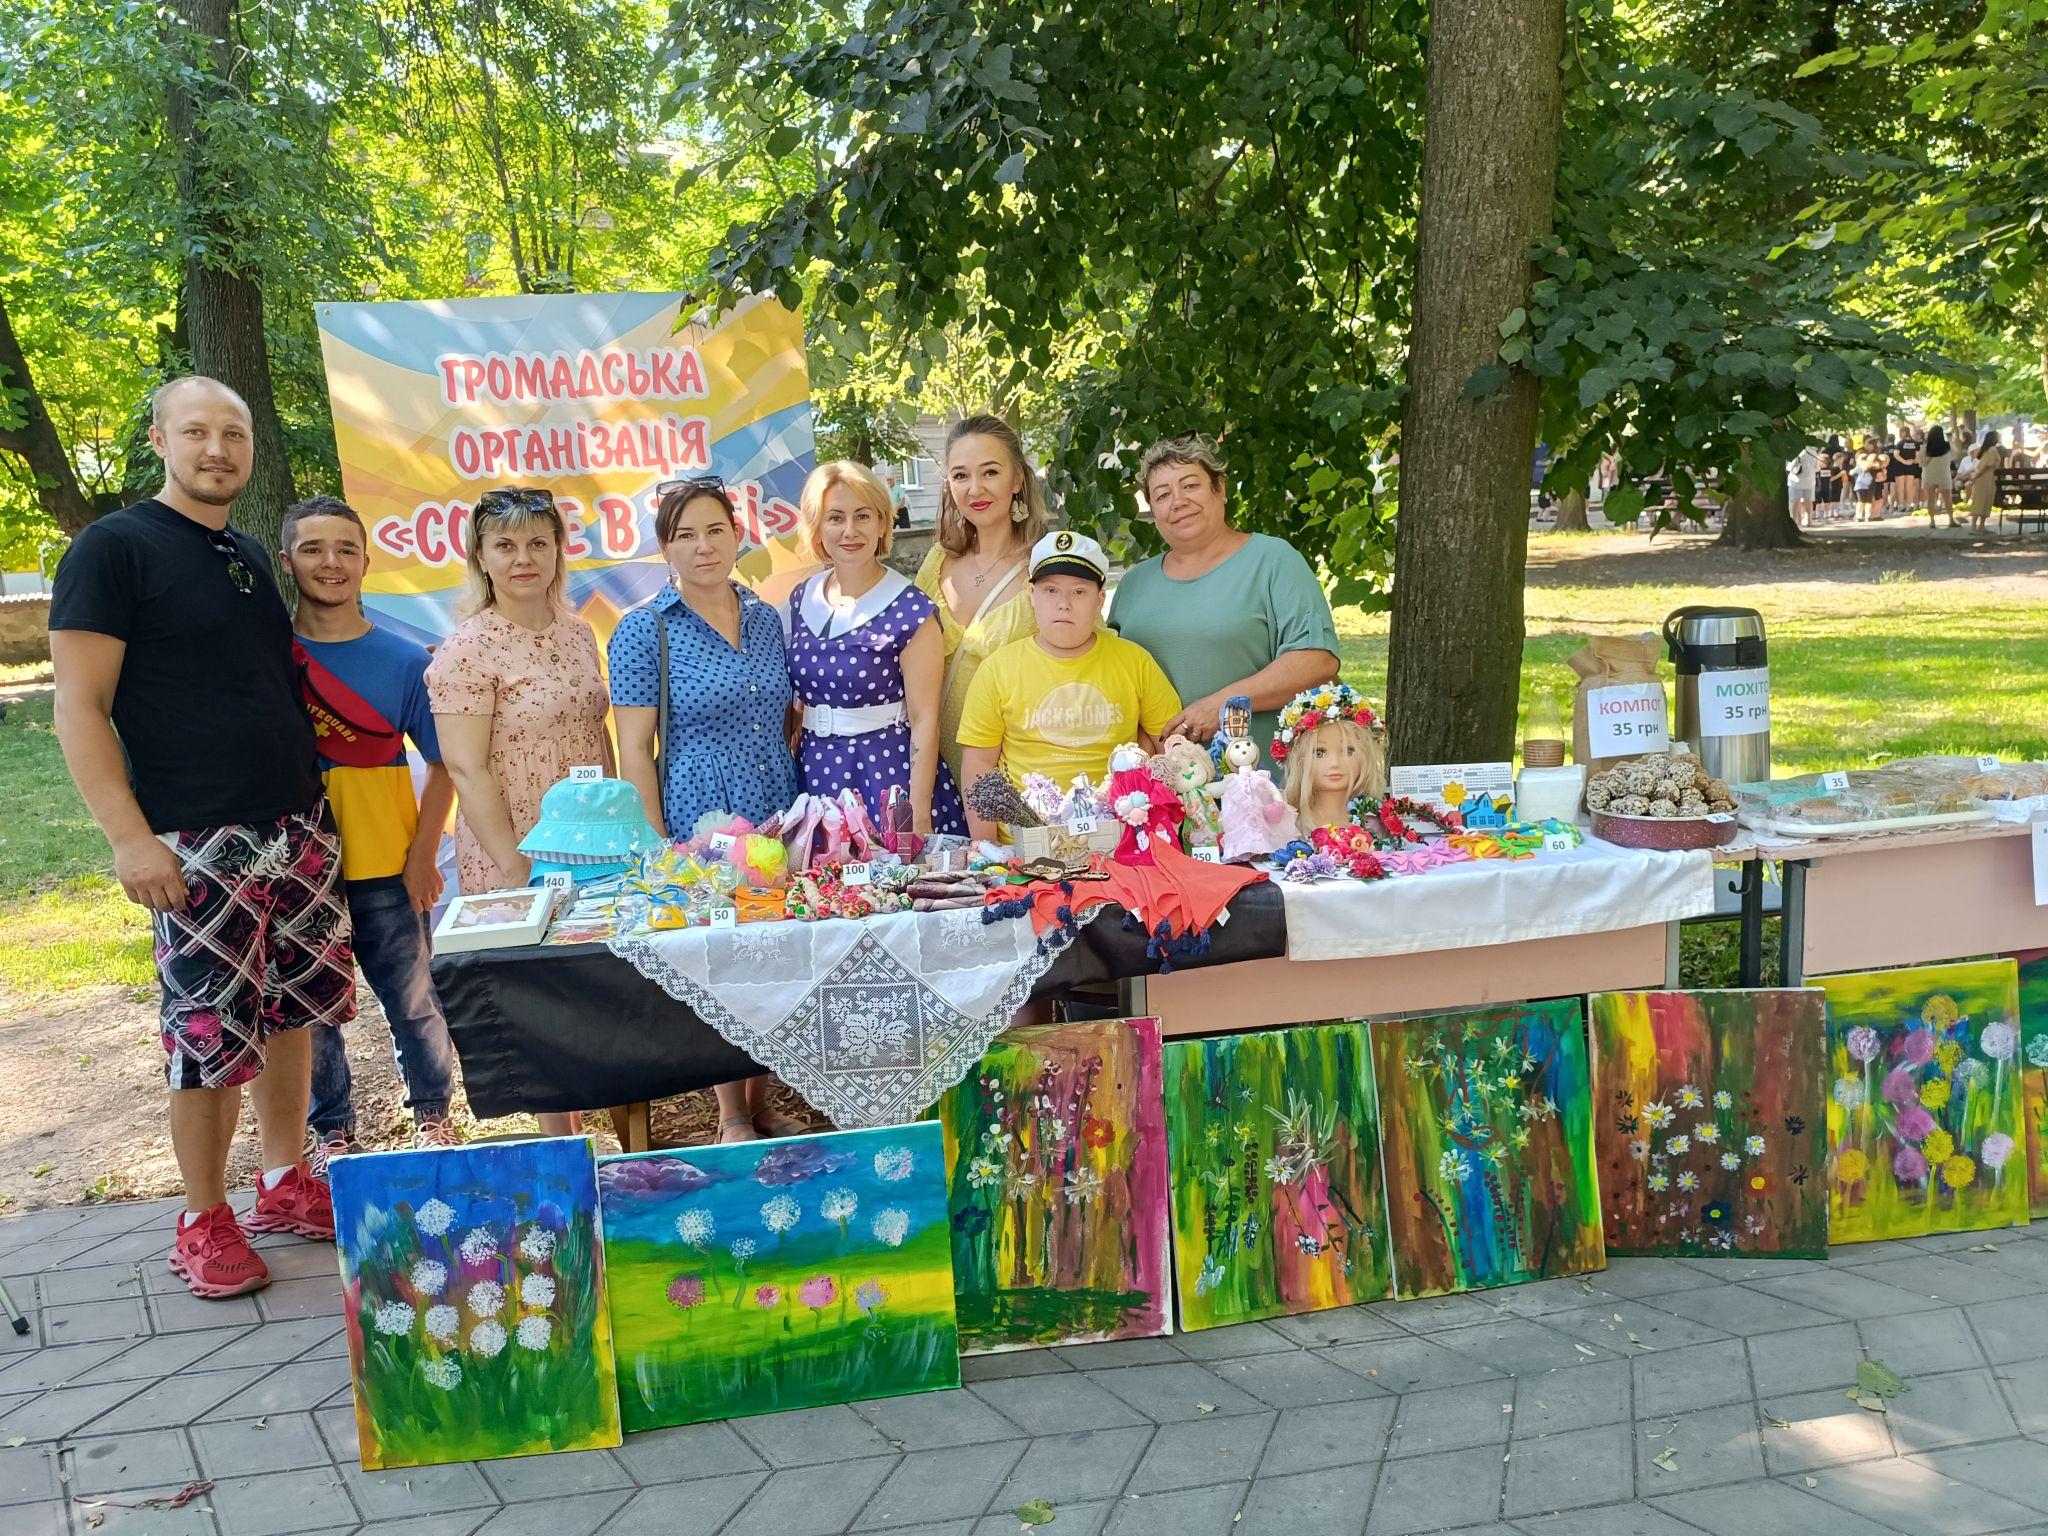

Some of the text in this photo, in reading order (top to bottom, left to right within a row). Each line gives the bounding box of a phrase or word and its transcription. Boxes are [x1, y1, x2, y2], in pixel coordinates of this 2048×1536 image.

[441, 351, 704, 402] ГРОМАДСЬКА
[455, 418, 708, 475] ОРГАНІЗАЦІЯ
[598, 498, 635, 553] В
[1725, 705, 1767, 720] 35 грн
[306, 703, 357, 742] IFEGUARD
[1613, 722, 1659, 737] 35 грн
[1982, 757, 1993, 766] 20
[576, 768, 597, 780] 200
[1832, 777, 1844, 788] 35
[1077, 821, 1090, 833] 50
[715, 840, 729, 850] 35
[1552, 840, 1565, 851] 60
[845, 864, 865, 875] 100
[545, 876, 565, 888] 140
[715, 908, 729, 921] 50
